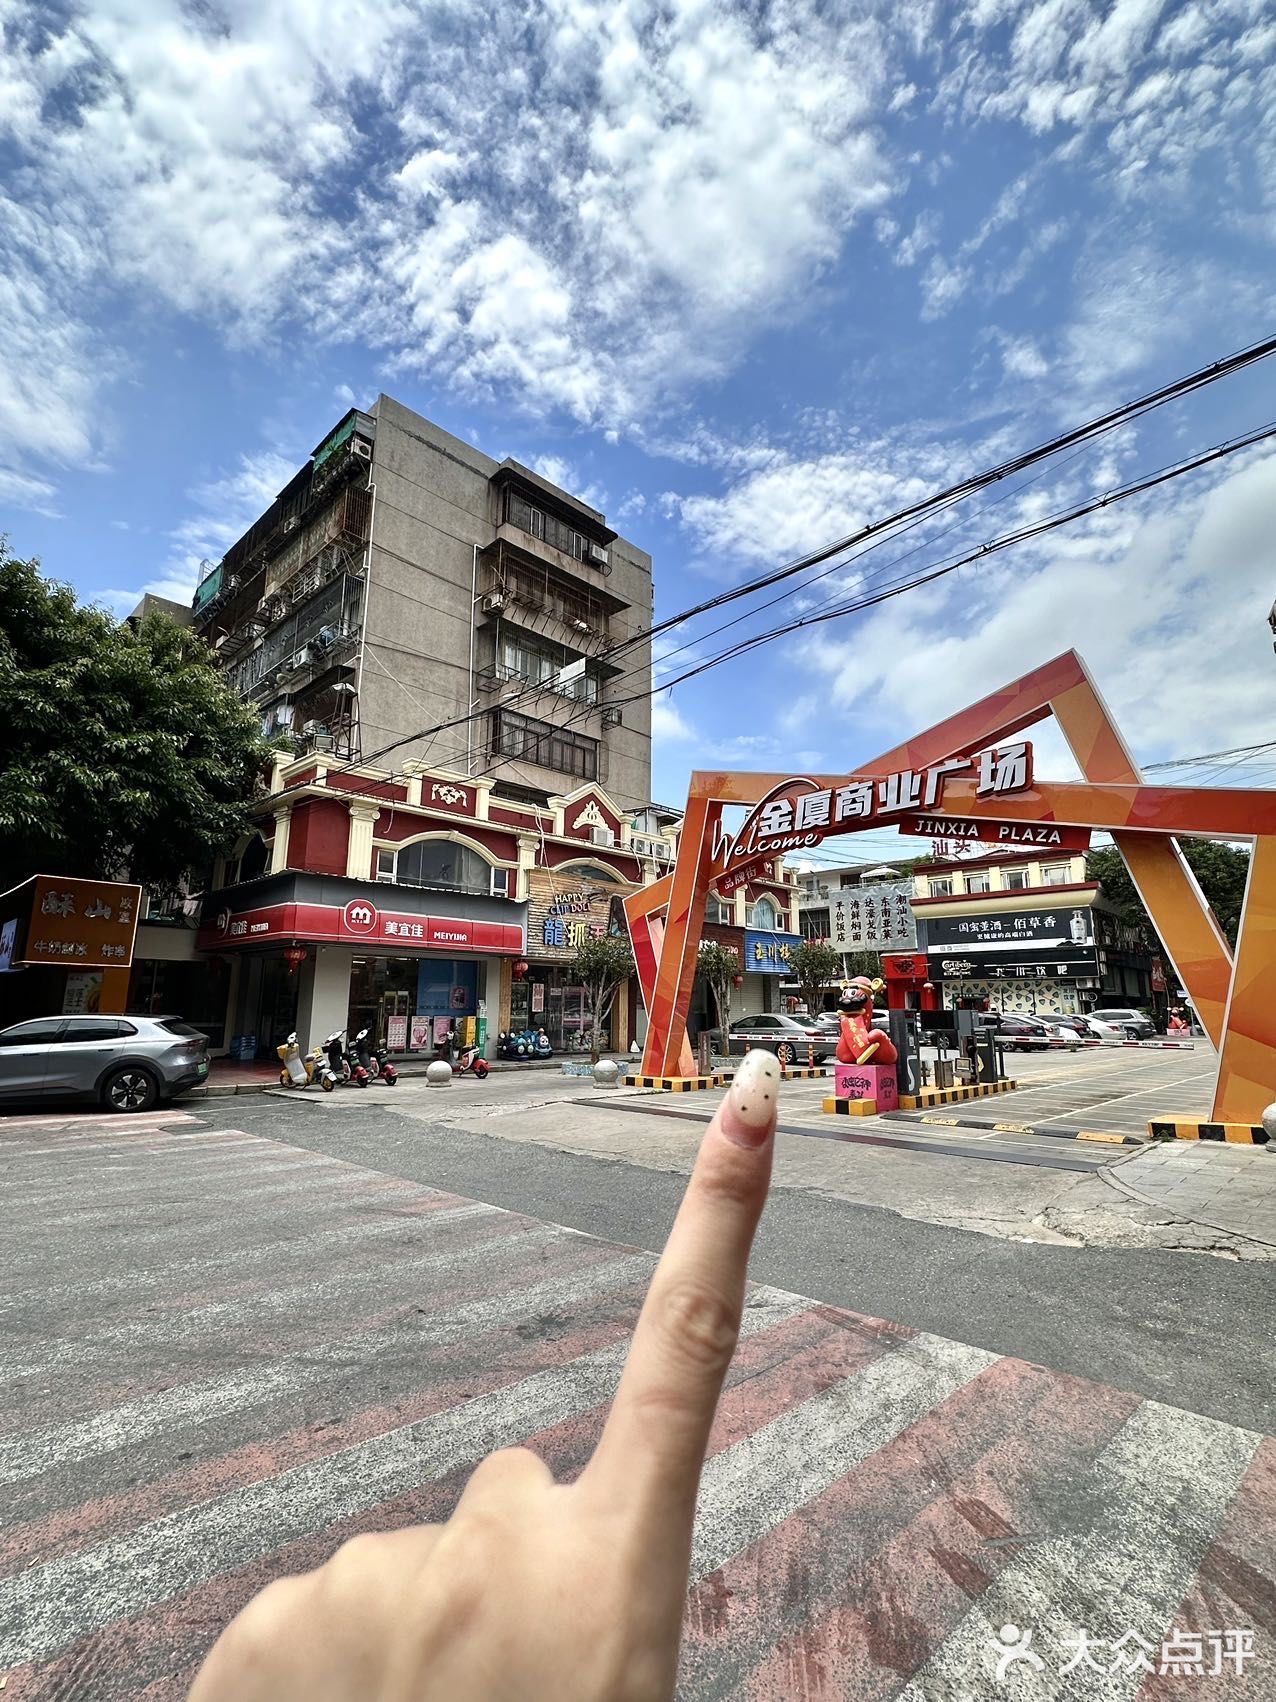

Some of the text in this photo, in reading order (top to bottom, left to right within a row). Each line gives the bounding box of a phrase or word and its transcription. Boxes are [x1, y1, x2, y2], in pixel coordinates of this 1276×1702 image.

[757, 741, 1029, 838] 金厦商业广场
[711, 814, 818, 869] Welcome
[914, 820, 1061, 844] JINXIA PLAZA
[554, 893, 584, 904] HAPPY
[384, 920, 424, 938] 美宜佳
[881, 896, 893, 940] 东南亚菜
[896, 894, 910, 938] 潮汕小吃
[433, 931, 468, 942] MEIYIJIA
